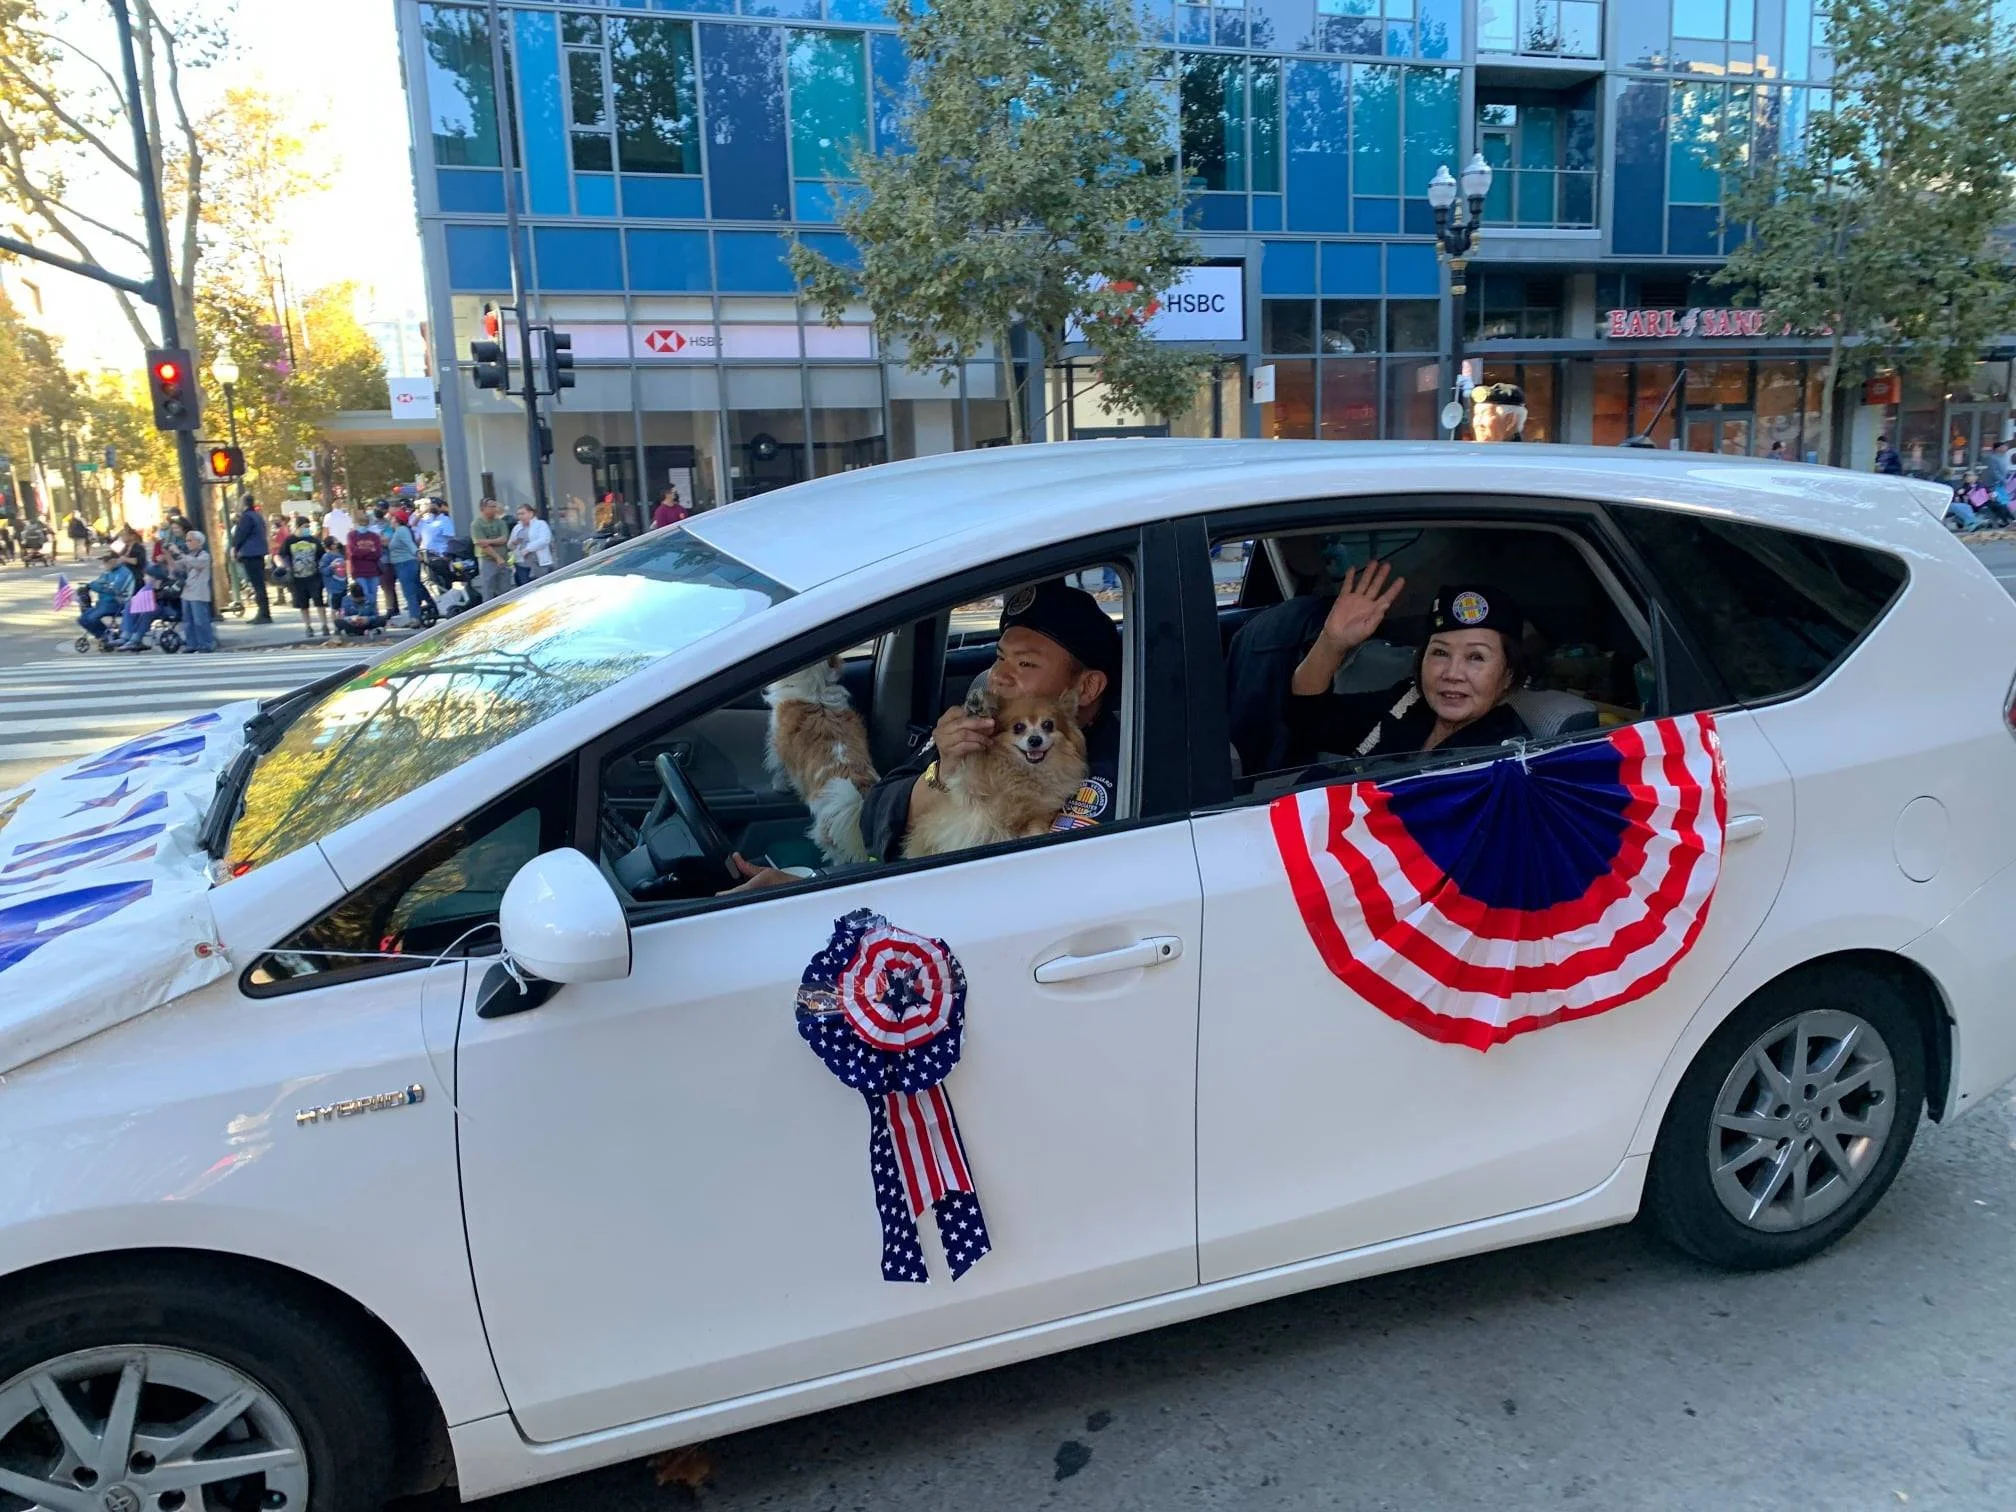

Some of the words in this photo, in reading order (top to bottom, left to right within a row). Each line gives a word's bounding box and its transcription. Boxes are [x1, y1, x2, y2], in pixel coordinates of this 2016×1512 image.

[1167, 294, 1225, 313] HSBC
[1609, 309, 1680, 337] EARL
[296, 1090, 405, 1127] HYBRID
